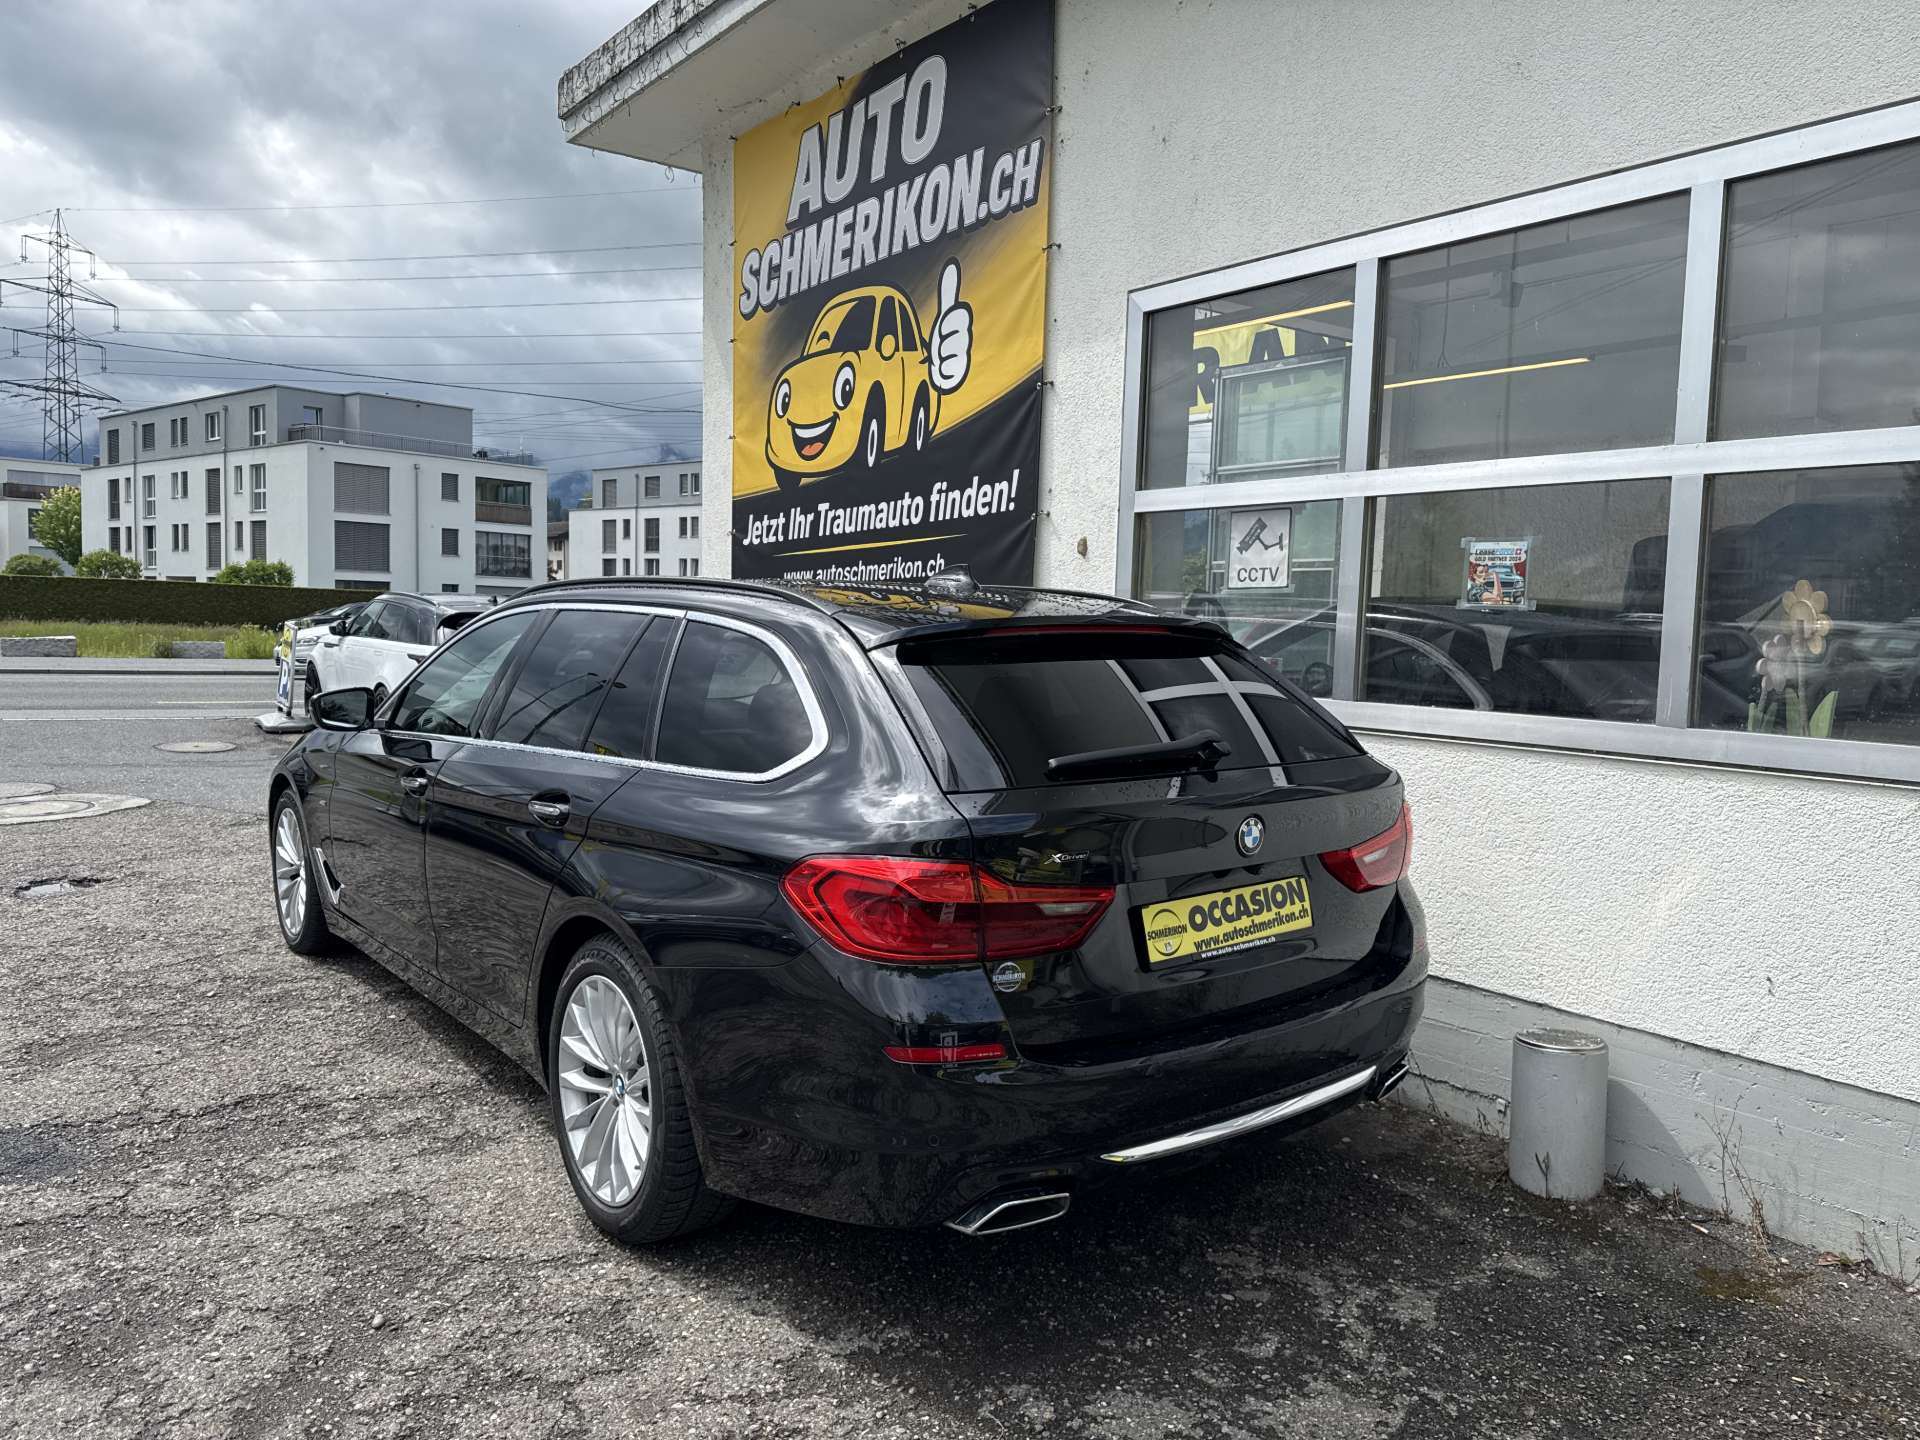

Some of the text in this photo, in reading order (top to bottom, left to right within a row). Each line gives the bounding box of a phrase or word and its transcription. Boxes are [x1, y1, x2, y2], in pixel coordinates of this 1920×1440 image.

[785, 54, 948, 228] AUTO
[739, 136, 1044, 319] SCHMERIKON.CH
[742, 468, 1021, 546] Jetzt Ihr Traumauto finden!
[784, 552, 945, 581] wwwautoschmerikon.ch
[1237, 566, 1281, 583] CCTV
[1188, 878, 1306, 932] OCCASION
[1194, 904, 1309, 952] www.autoschmerikon.ch
[1147, 924, 1188, 941] SCHMERIKON
